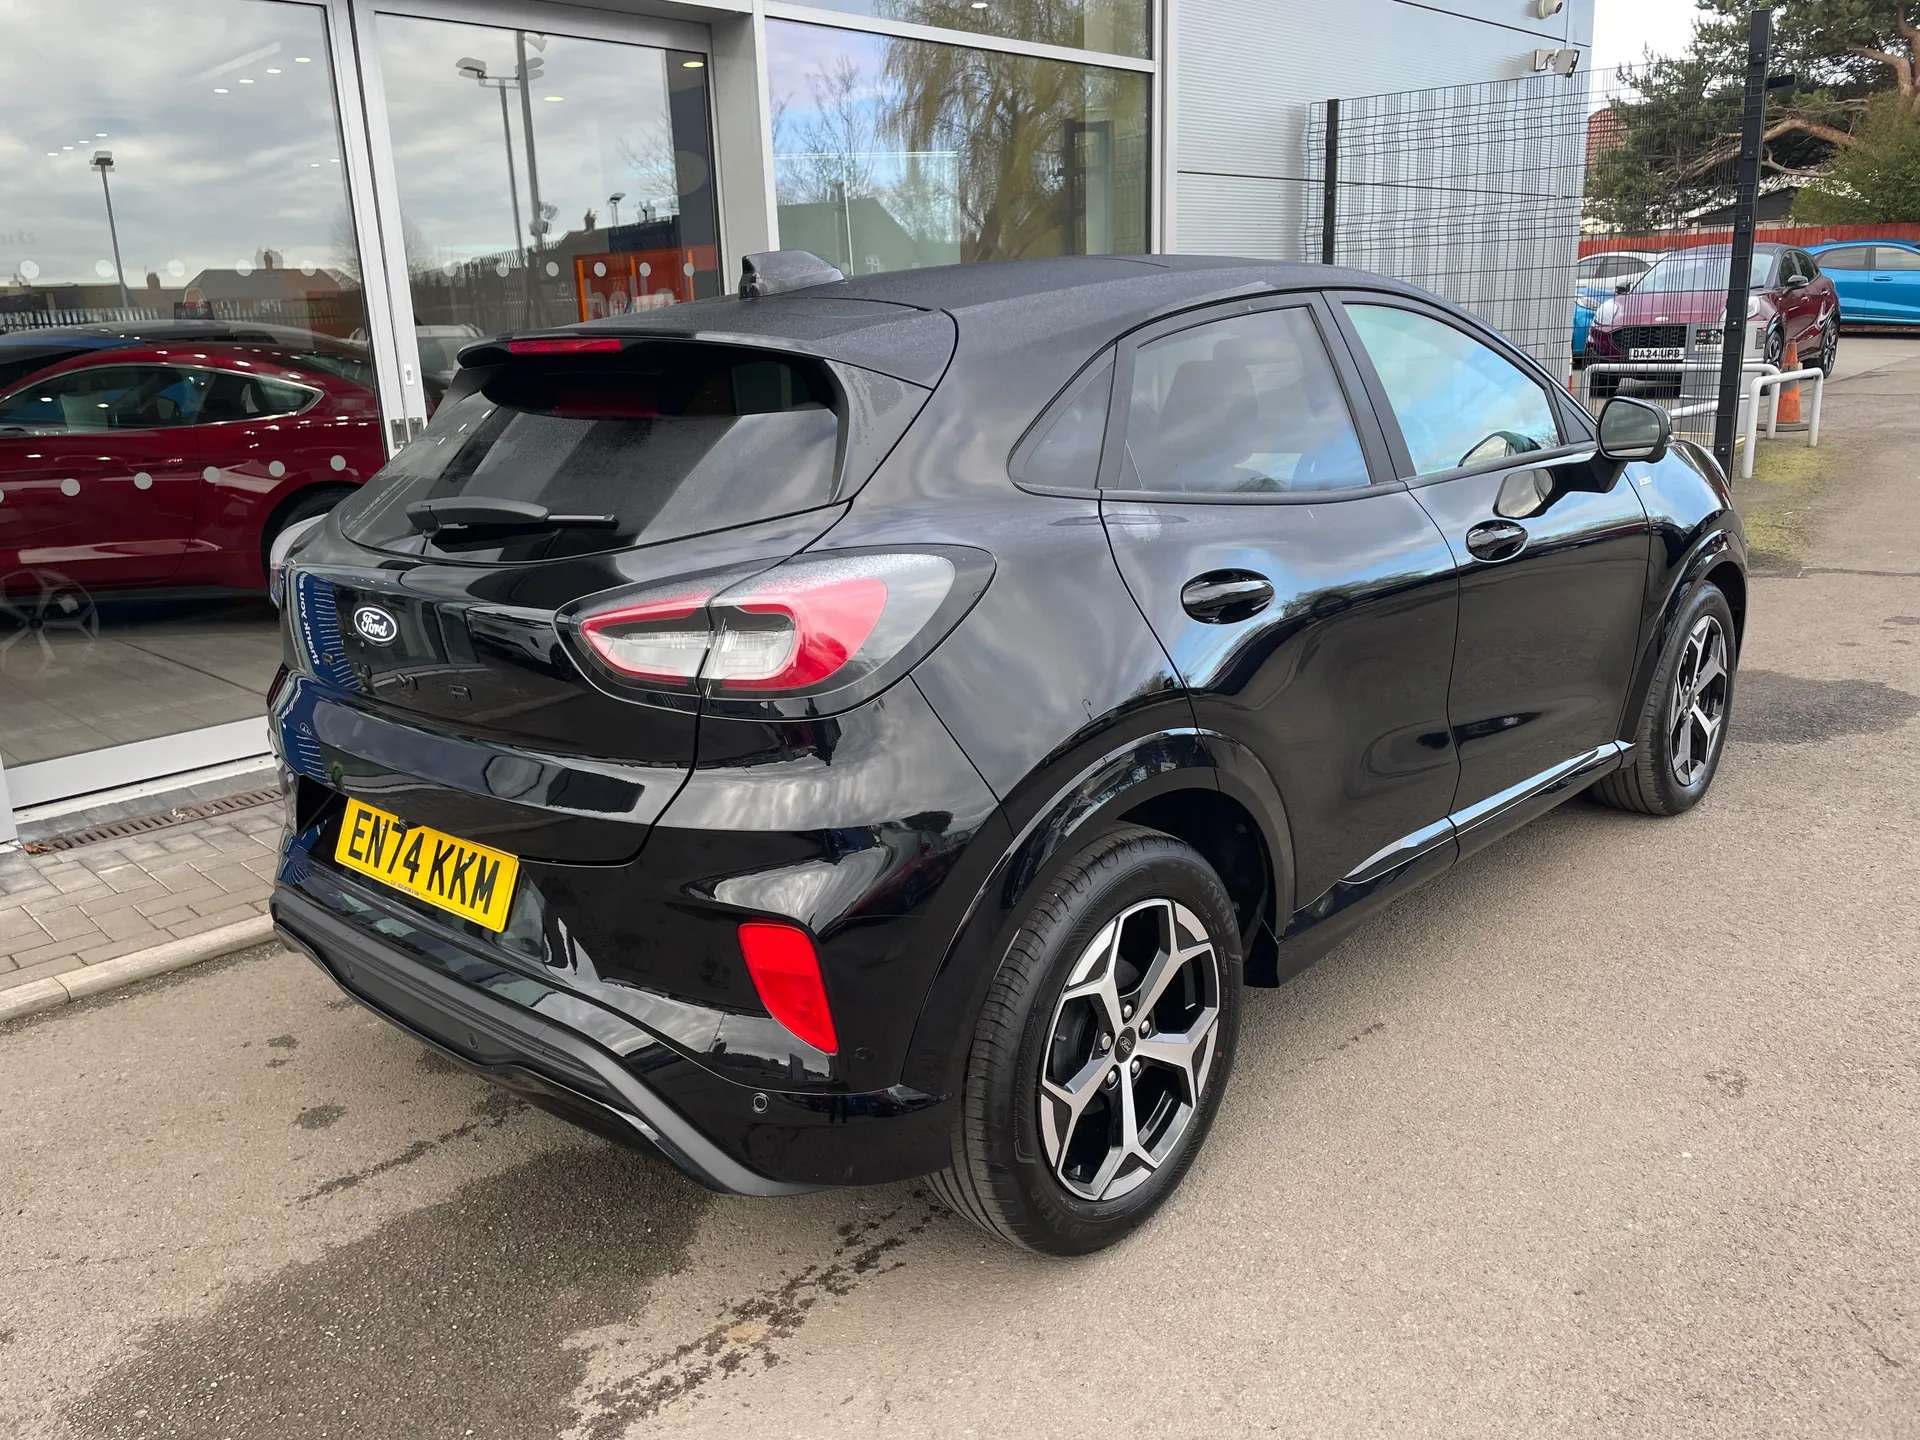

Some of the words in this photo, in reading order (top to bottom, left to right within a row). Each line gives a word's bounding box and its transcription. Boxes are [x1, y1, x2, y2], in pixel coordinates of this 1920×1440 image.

[360, 612, 388, 638] Ford
[348, 810, 424, 883] EN74
[427, 844, 502, 916] KKM
